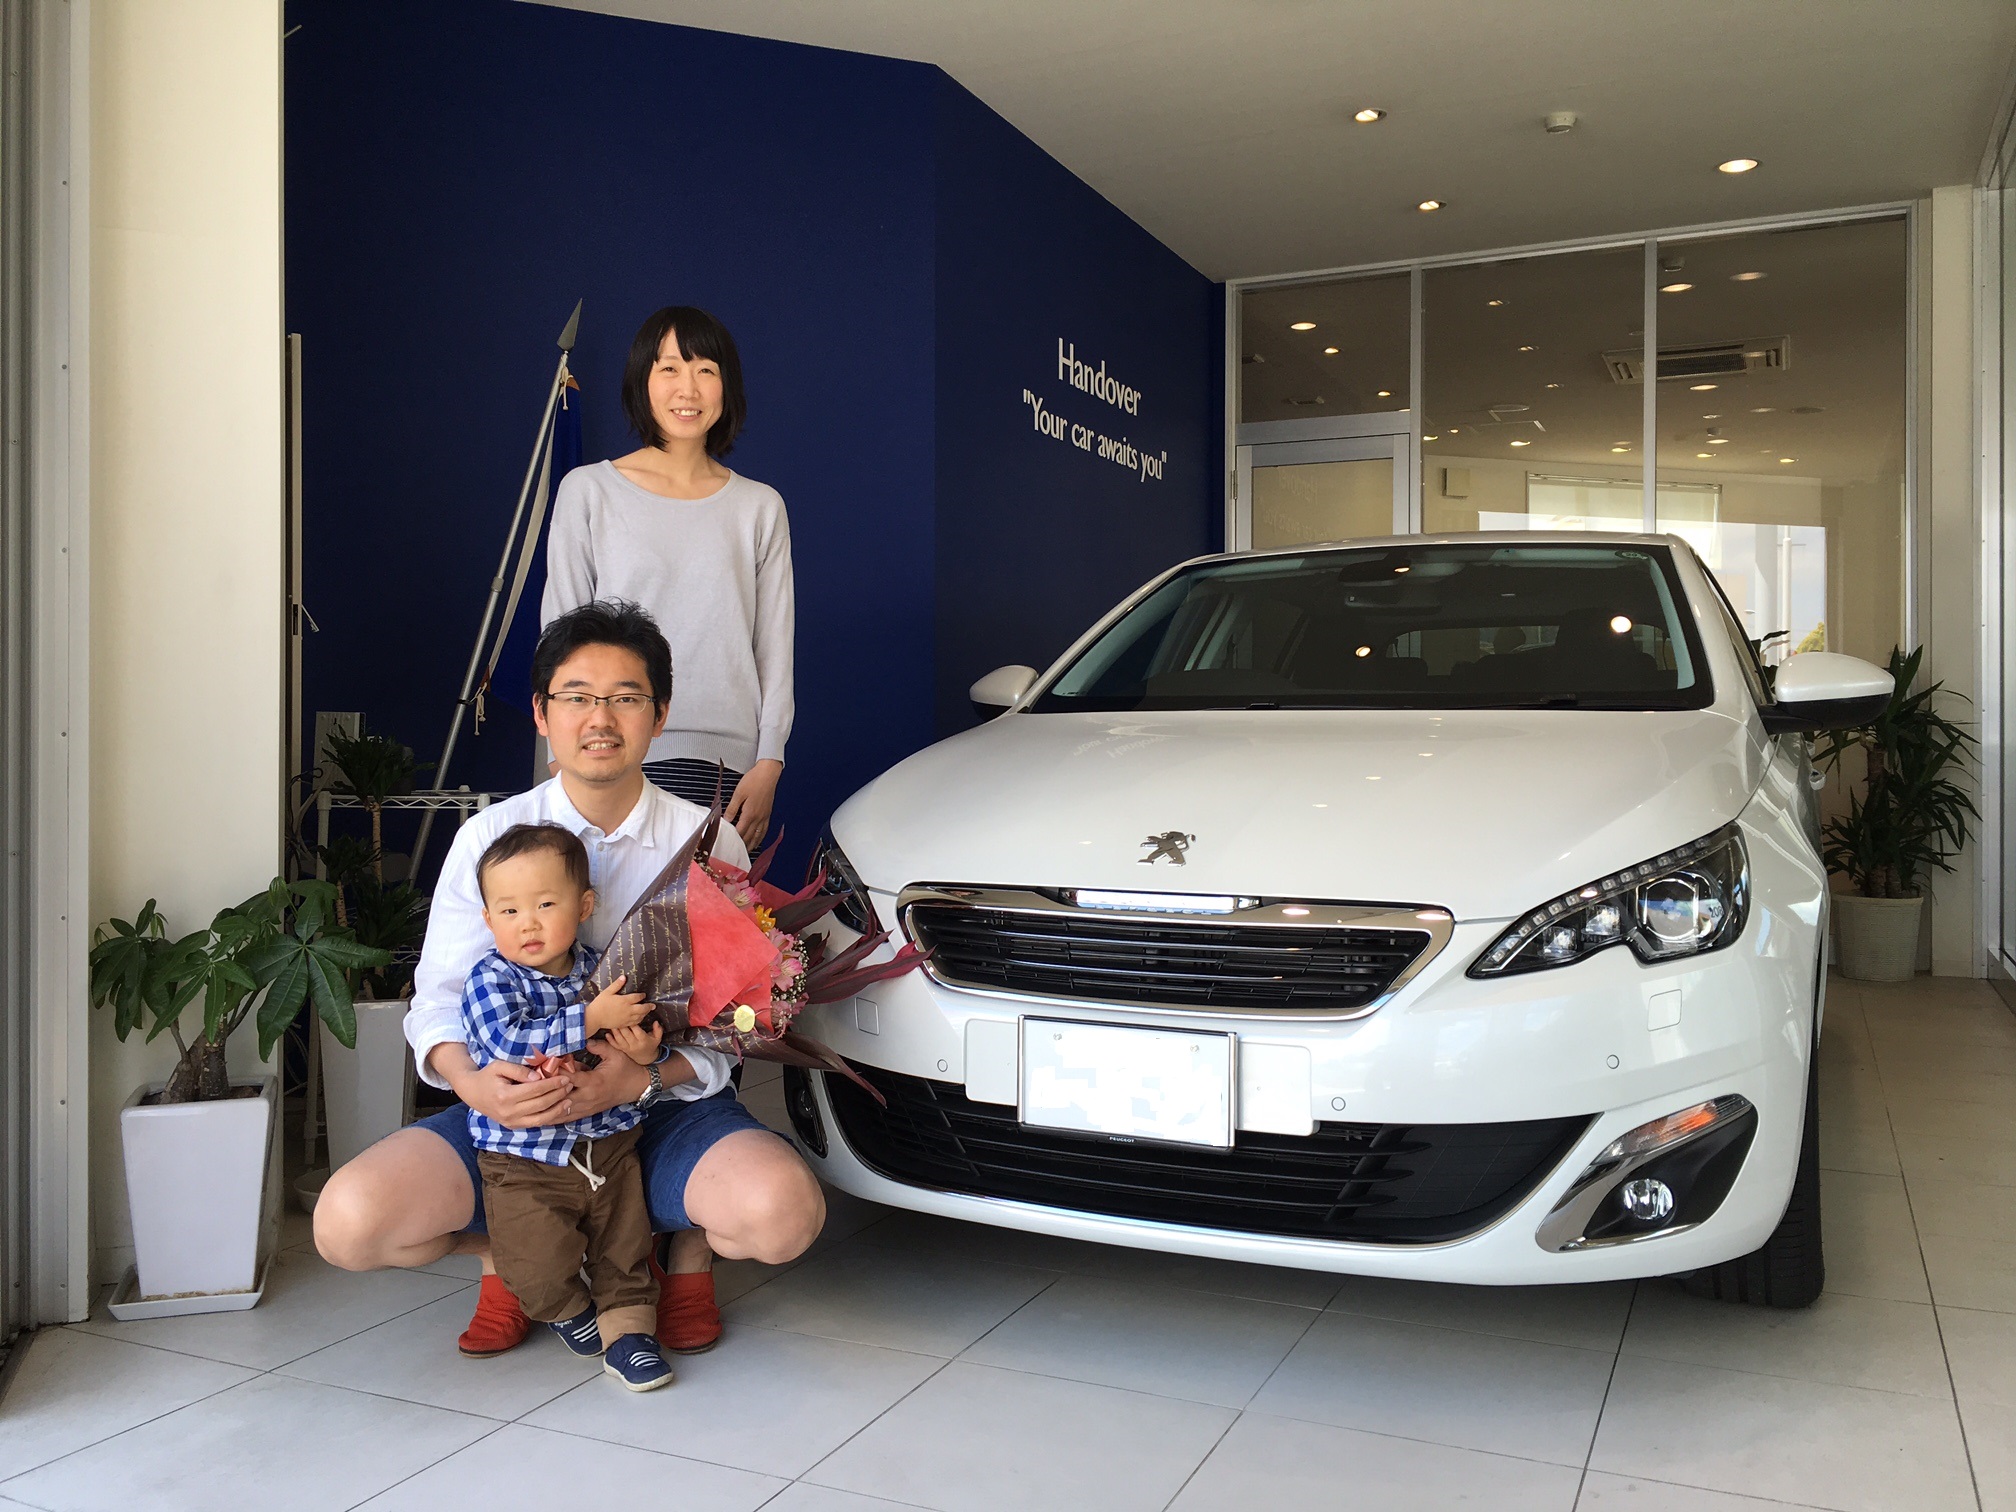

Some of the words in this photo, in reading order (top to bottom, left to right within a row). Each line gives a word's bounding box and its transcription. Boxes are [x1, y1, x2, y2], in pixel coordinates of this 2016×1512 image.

[1058, 337, 1142, 416] Handover
[1023, 388, 1068, 441] "Your
[1071, 423, 1095, 452] car
[1097, 434, 1138, 471] awaits
[1140, 450, 1167, 483] you"
